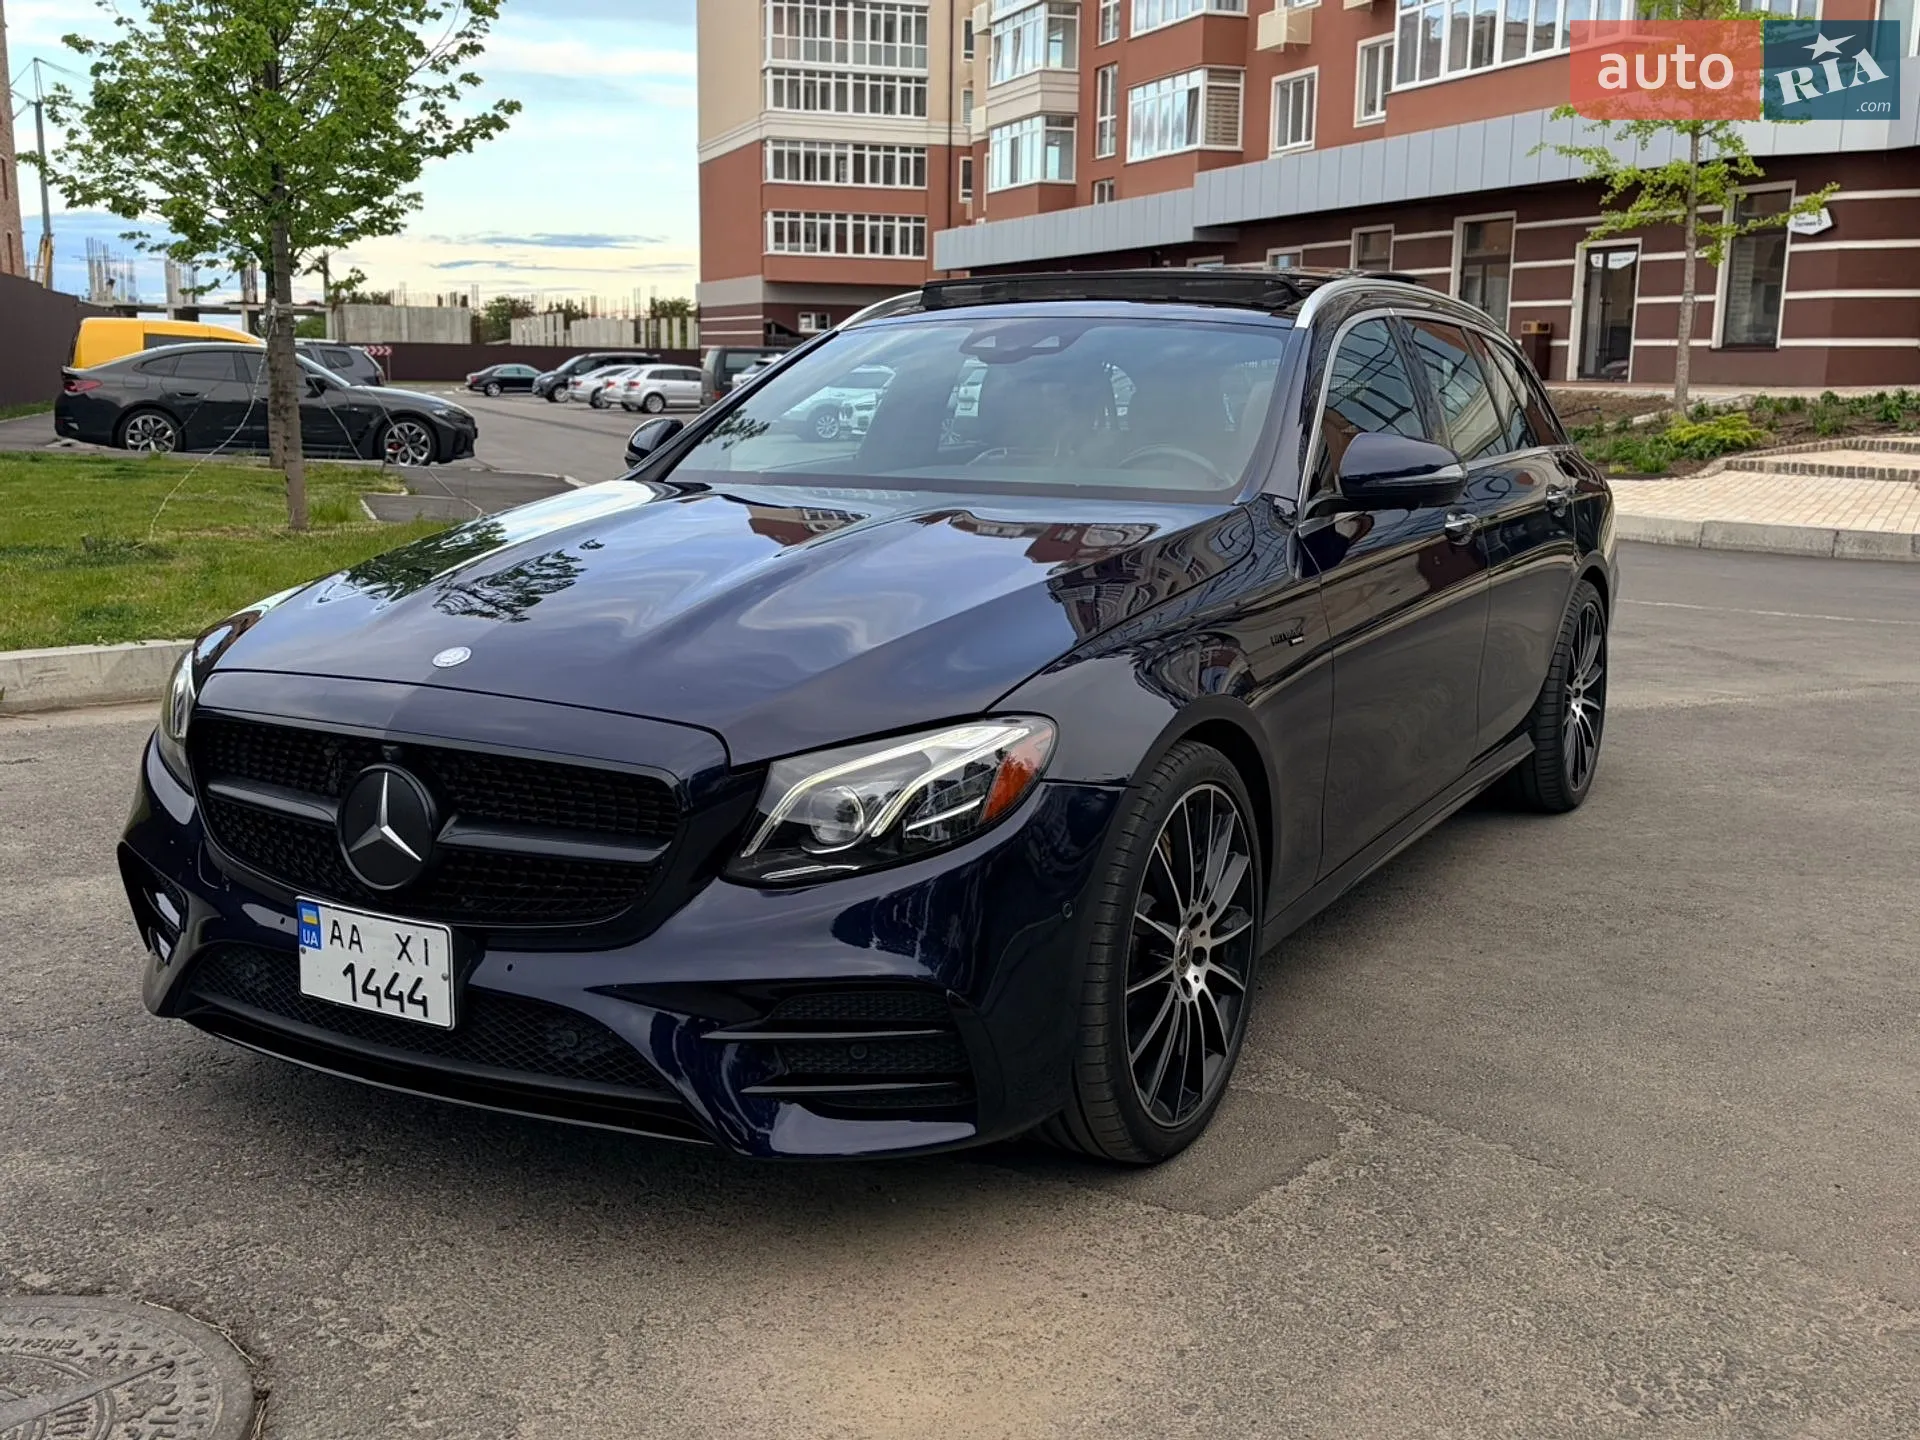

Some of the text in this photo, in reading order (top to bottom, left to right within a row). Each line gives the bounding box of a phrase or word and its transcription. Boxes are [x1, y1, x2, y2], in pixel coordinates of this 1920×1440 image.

[302, 929, 319, 947] UA
[330, 919, 430, 966] AA XI
[342, 962, 429, 1018] 1444
